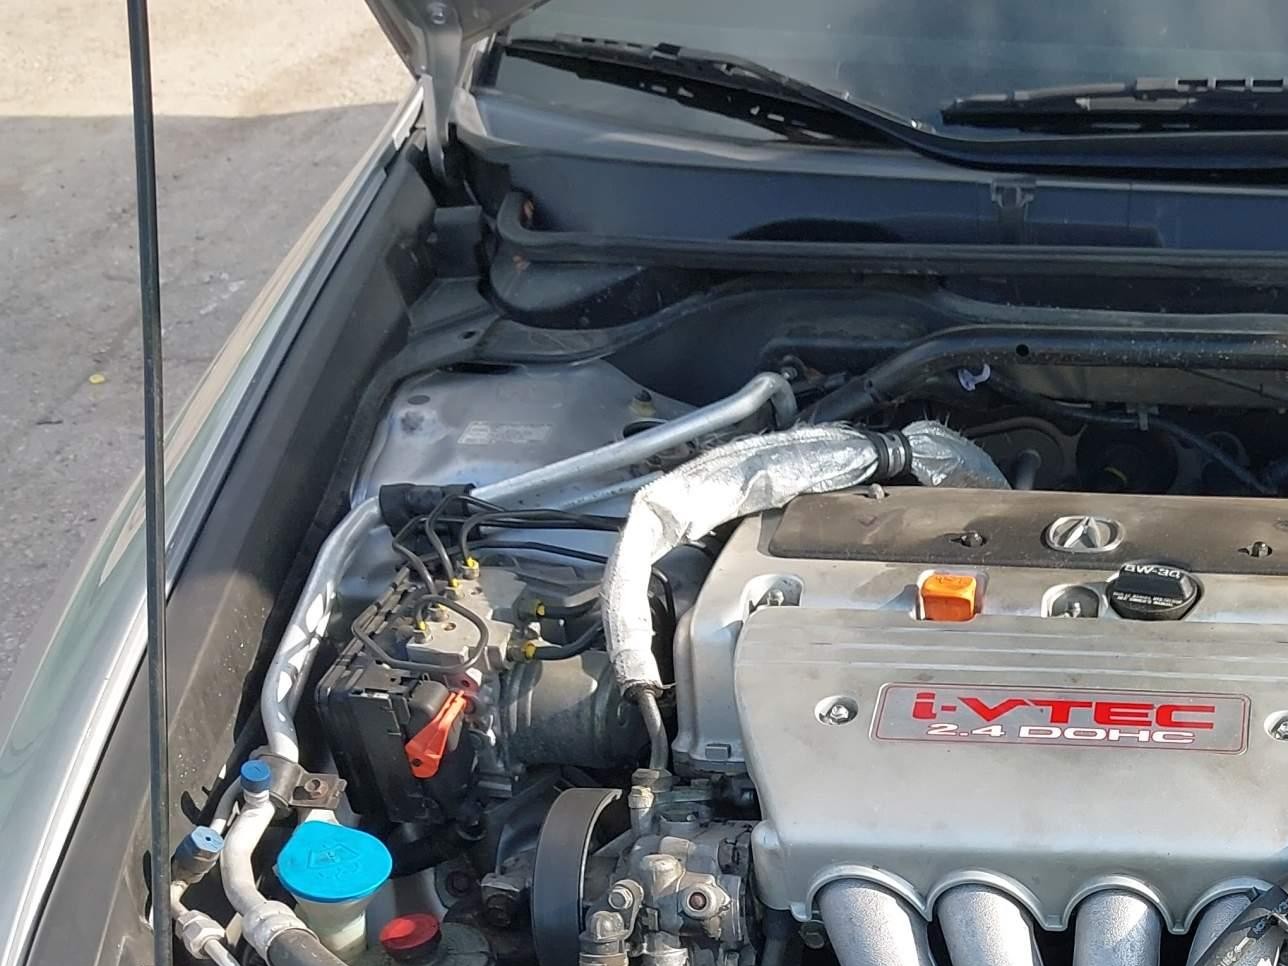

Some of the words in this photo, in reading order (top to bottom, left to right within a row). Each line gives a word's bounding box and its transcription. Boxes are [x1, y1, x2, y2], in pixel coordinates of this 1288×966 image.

[911, 692, 1216, 730] i-VTEC
[926, 723, 1006, 738] 2.4
[1018, 725, 1196, 744] DOHC
